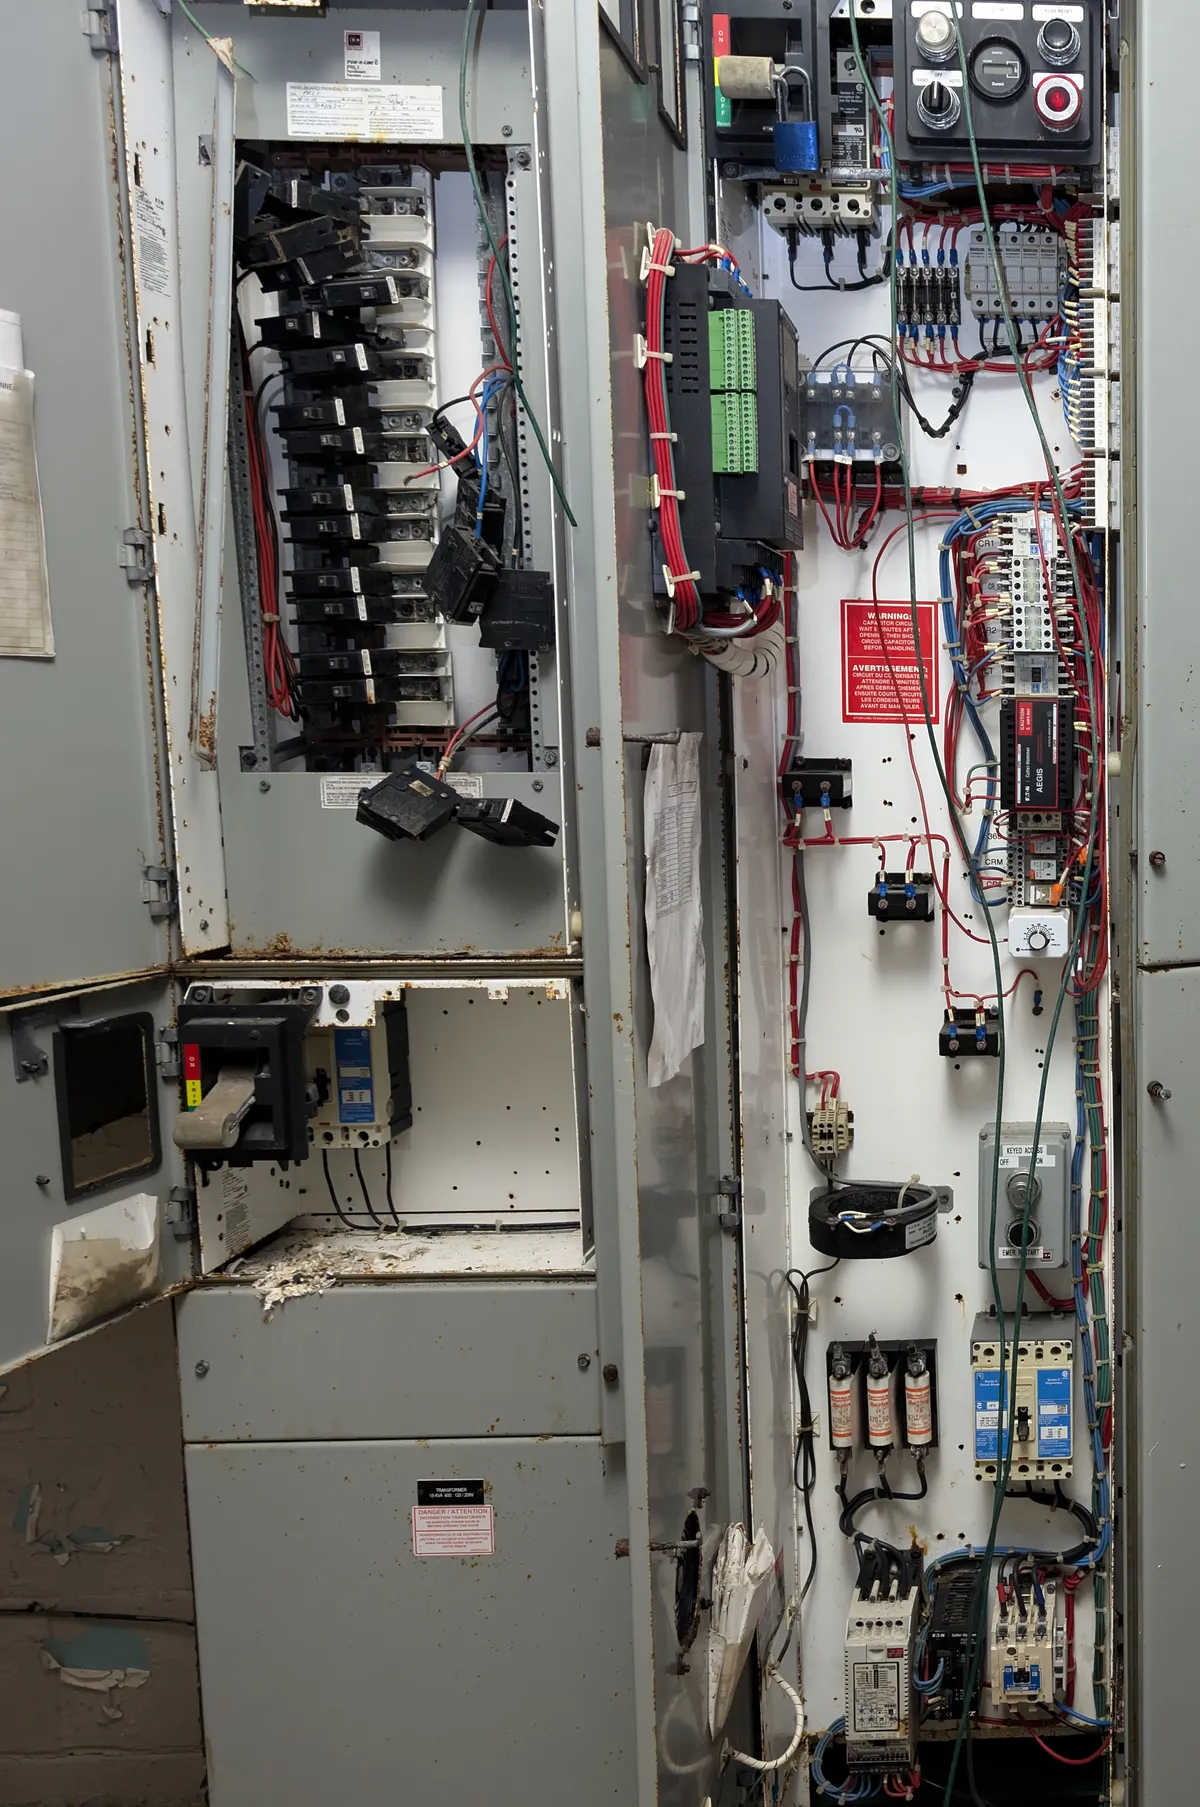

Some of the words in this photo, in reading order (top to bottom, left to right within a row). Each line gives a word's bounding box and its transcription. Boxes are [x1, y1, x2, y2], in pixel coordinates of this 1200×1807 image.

[718, 30, 724, 43] ON
[978, 539, 995, 547] CR1
[1036, 768, 1044, 793] AEGIS
[189, 1056, 195, 1068] ON
[1002, 1249, 1017, 1257] EMER.
